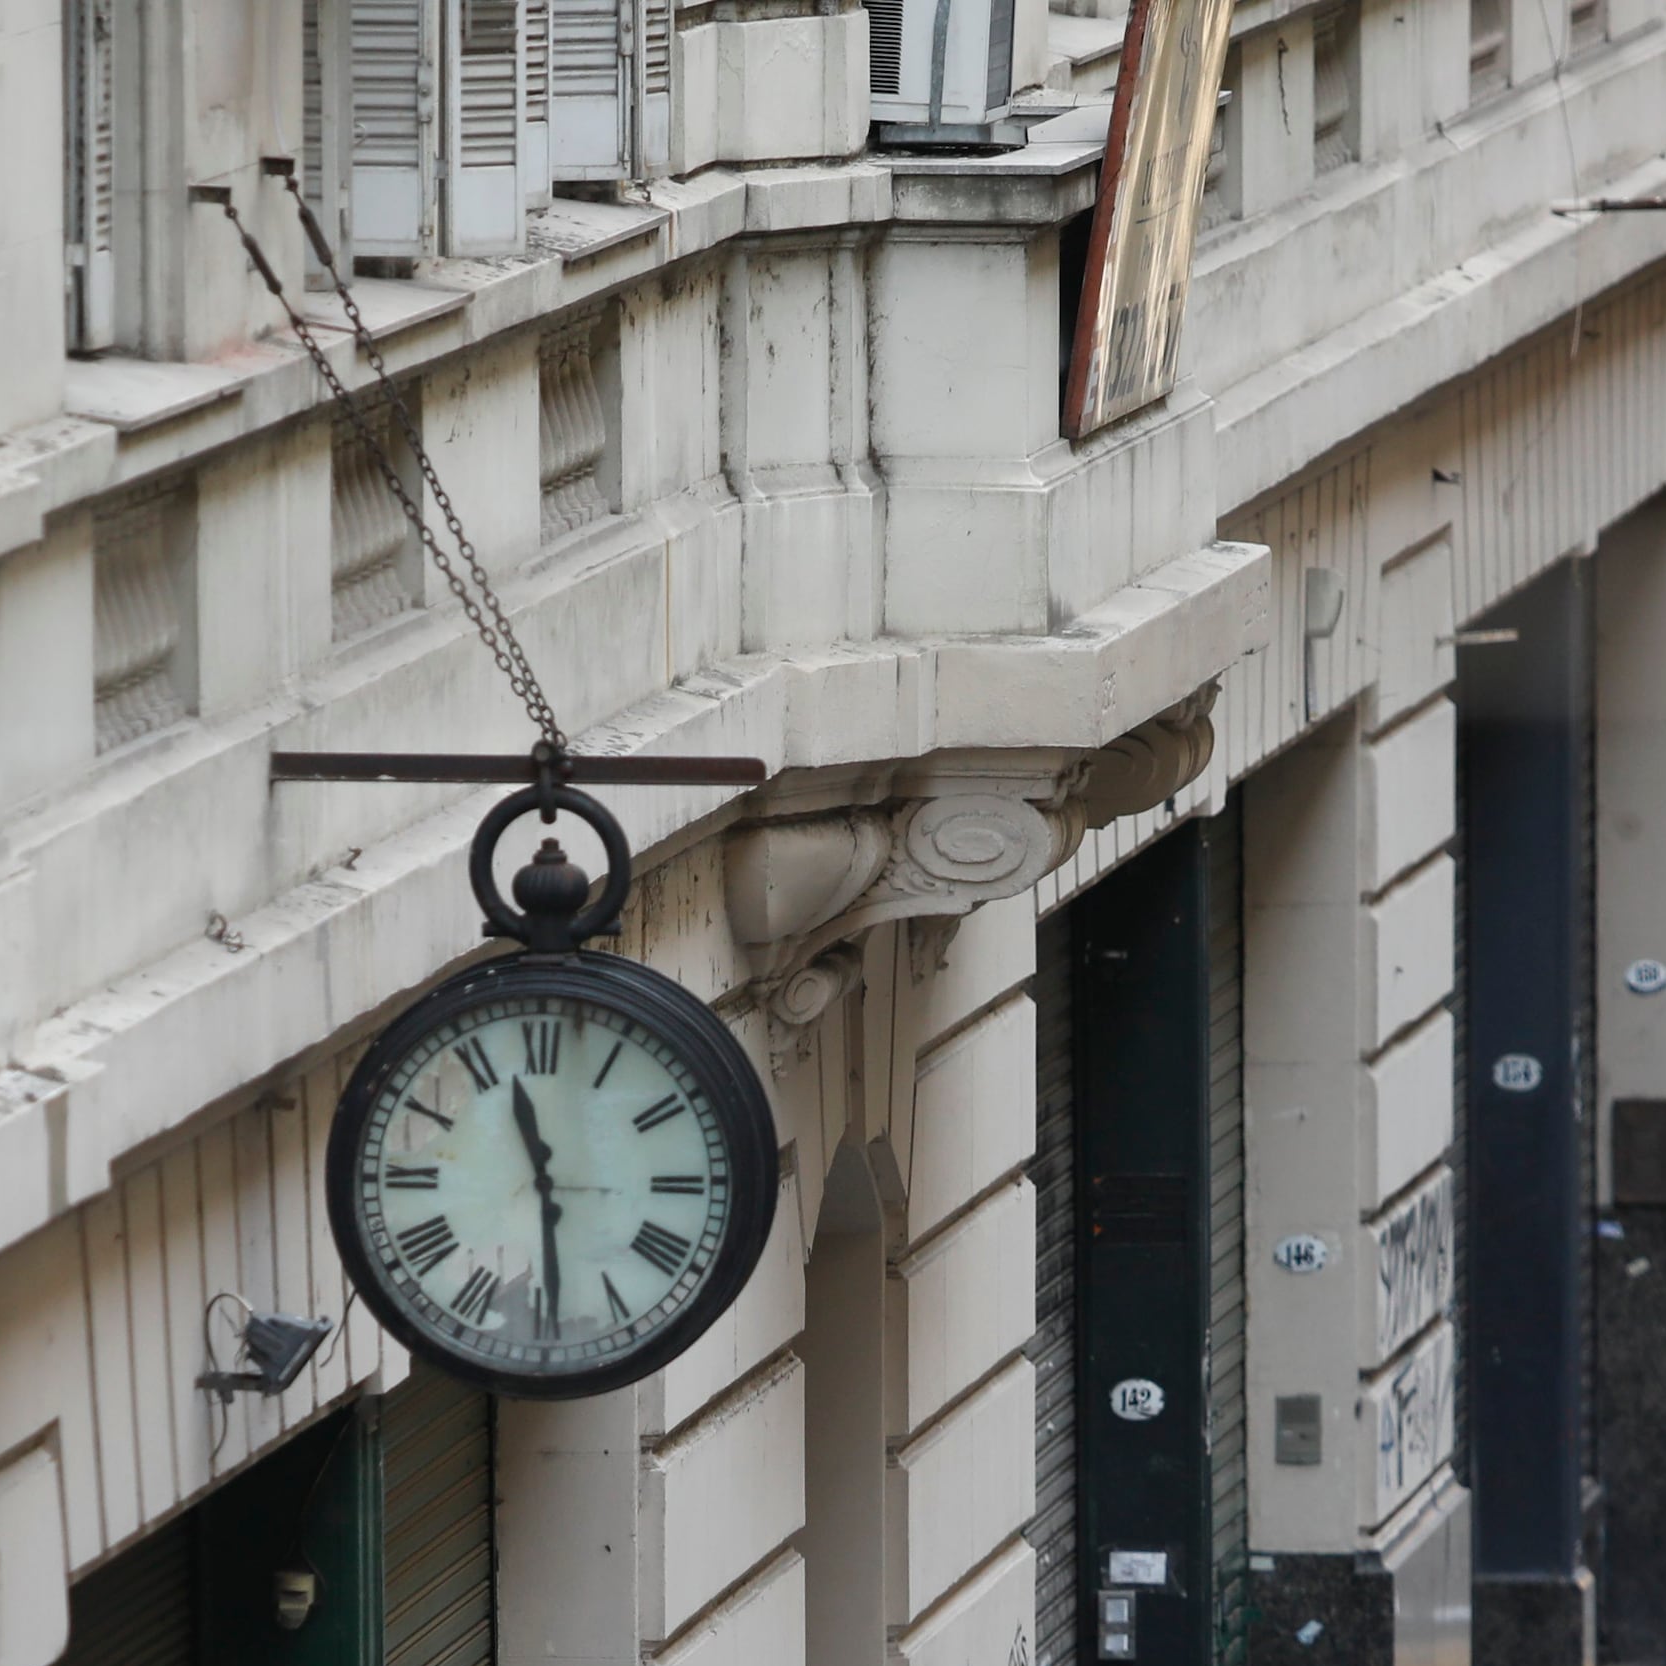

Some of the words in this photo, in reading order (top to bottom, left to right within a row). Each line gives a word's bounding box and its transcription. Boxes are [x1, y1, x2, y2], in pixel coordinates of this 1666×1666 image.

[453, 1035, 499, 1094] XI
[521, 1021, 561, 1075] XII
[594, 1040, 623, 1089] I
[632, 1093, 686, 1133] II
[385, 1163, 439, 1190] IX
[396, 1213, 460, 1278] VIII
[629, 1219, 692, 1278] IIII
[1285, 1242, 1315, 1266] 146
[449, 1265, 501, 1326] VII
[600, 1270, 631, 1325] V
[1120, 1387, 1152, 1413] 142
